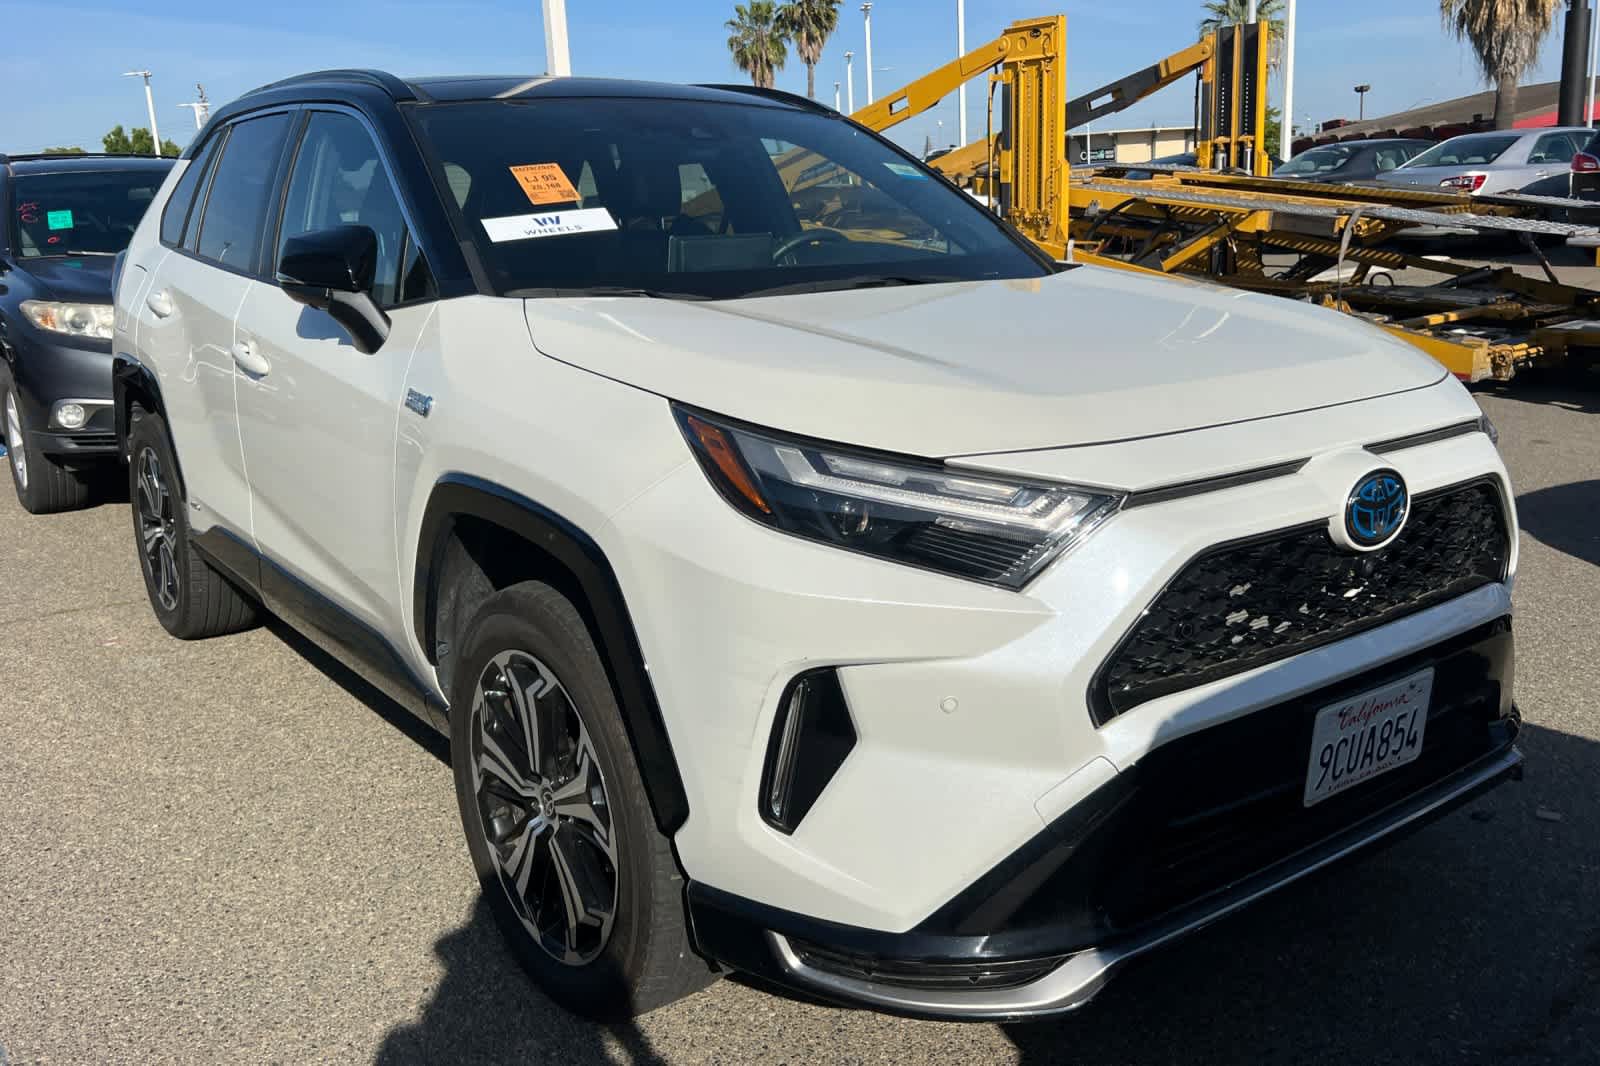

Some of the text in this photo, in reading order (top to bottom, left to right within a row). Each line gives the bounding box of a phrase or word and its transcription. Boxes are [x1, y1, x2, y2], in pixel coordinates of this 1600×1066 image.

[524, 225, 583, 236] WHEELS
[1338, 693, 1409, 730] California
[1314, 708, 1418, 791] 9CUA854
